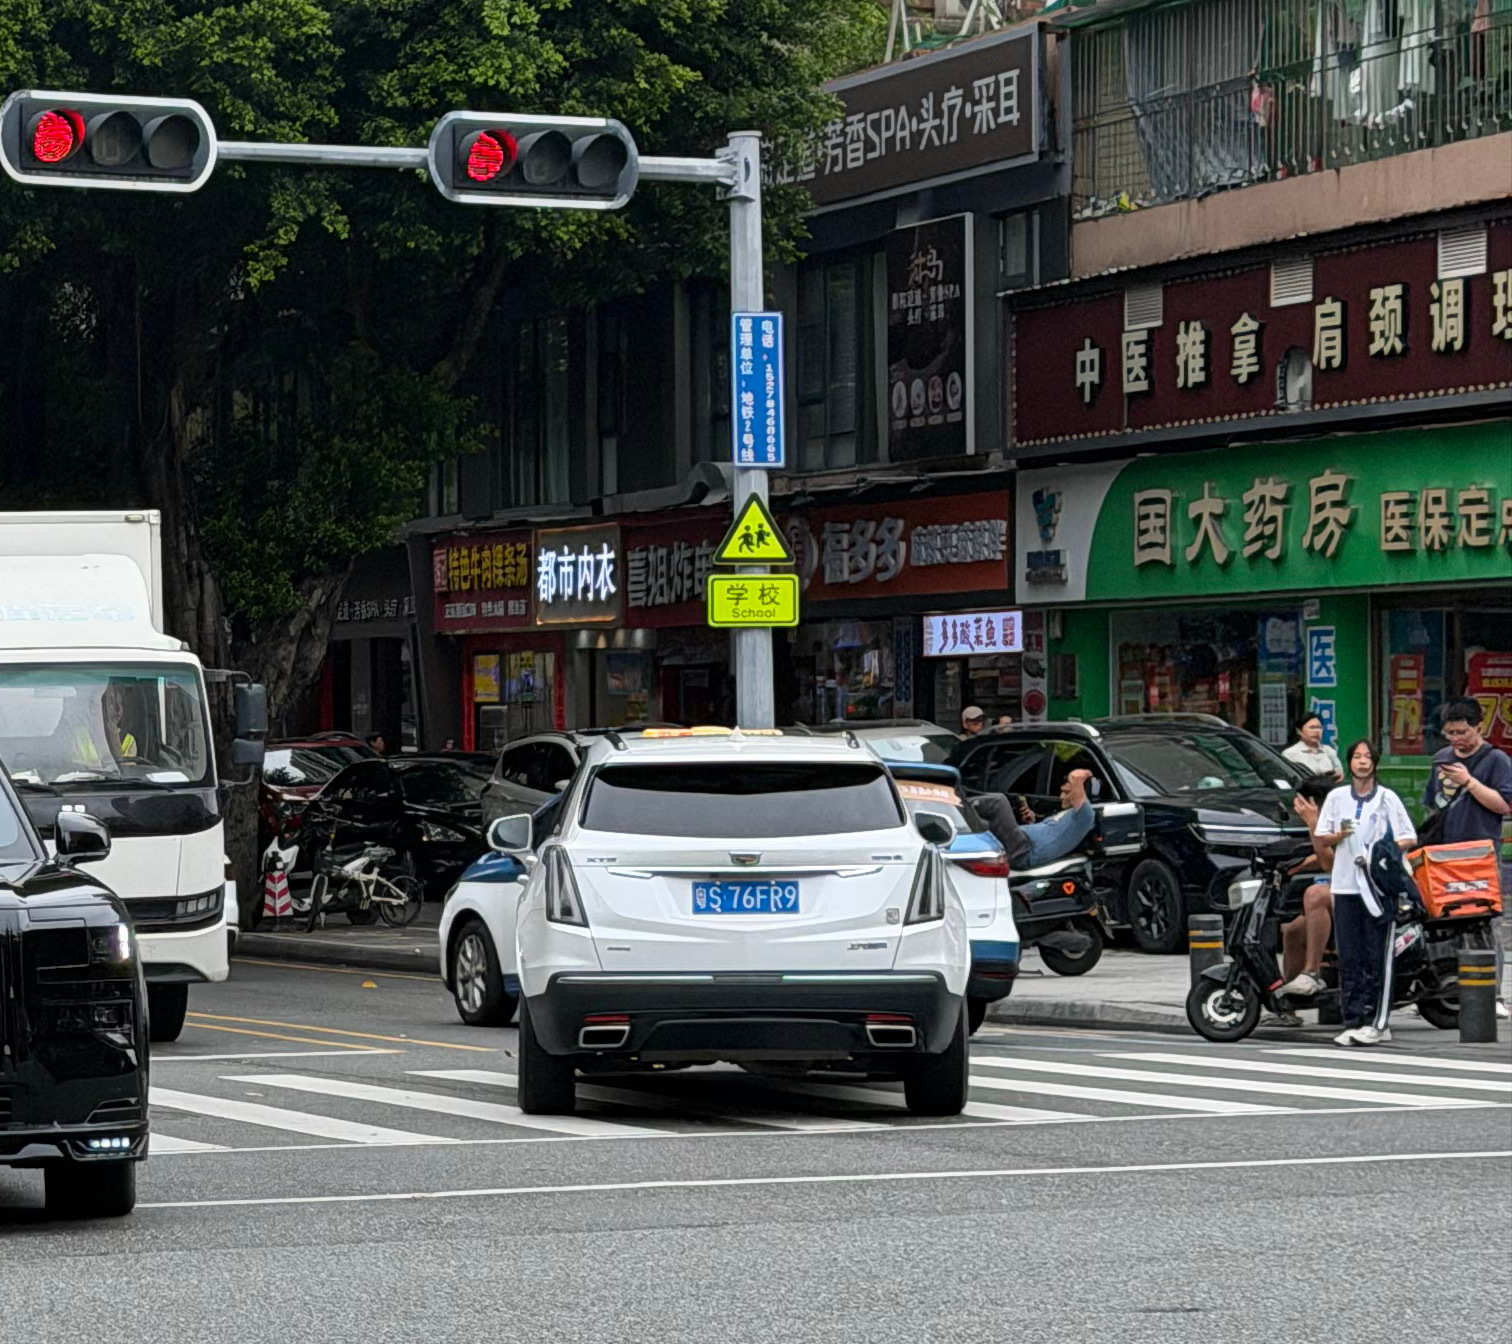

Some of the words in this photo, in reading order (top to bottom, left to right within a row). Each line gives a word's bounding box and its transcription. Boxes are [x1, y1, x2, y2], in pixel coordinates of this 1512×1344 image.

[1076, 312, 1260, 403] 中医推拿
[1133, 469, 1352, 567] 国大药房
[537, 542, 617, 604] 都市内衣
[726, 583, 780, 606] 学校
[731, 607, 776, 618] School
